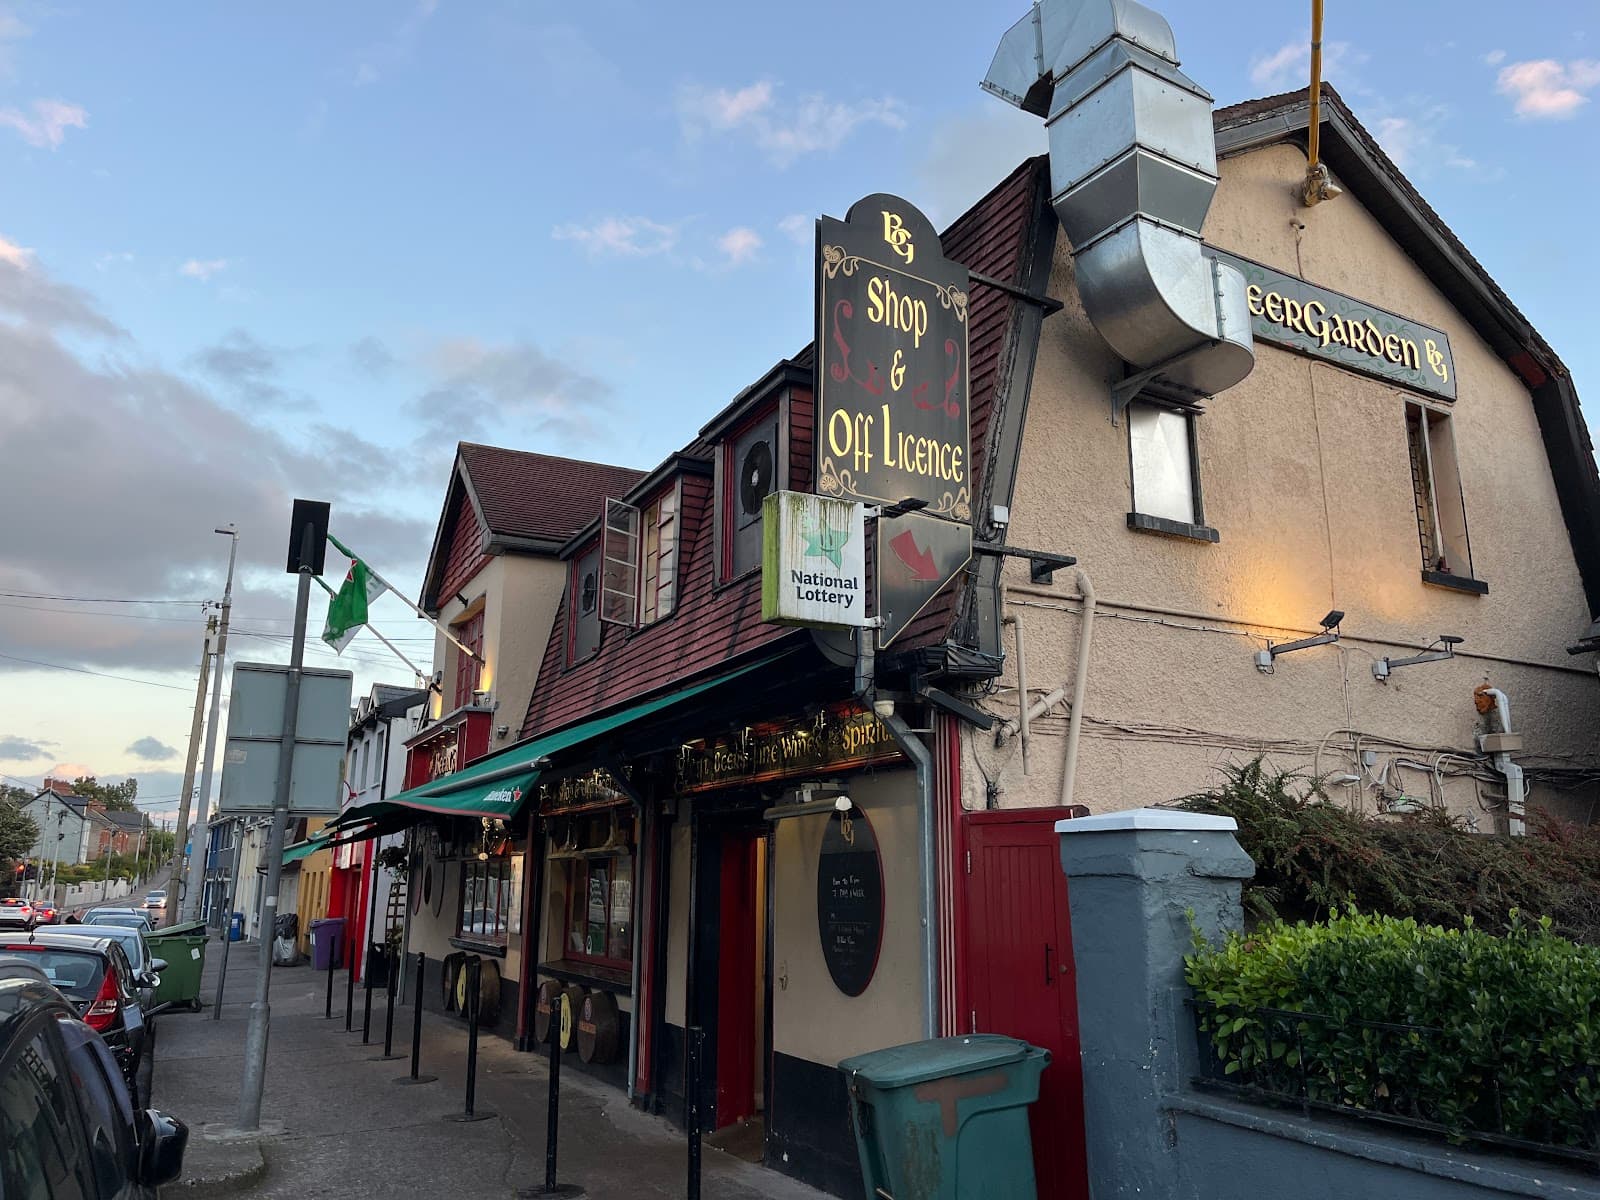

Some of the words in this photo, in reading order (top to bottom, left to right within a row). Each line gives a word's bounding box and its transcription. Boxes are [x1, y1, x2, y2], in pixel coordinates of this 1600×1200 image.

[867, 276, 928, 349] Shop
[1246, 284, 1421, 370] eerGarden
[889, 349, 906, 392] &
[828, 408, 874, 474] Off
[882, 403, 964, 483] Licence
[791, 569, 859, 590] National
[796, 586, 854, 609] Lottery
